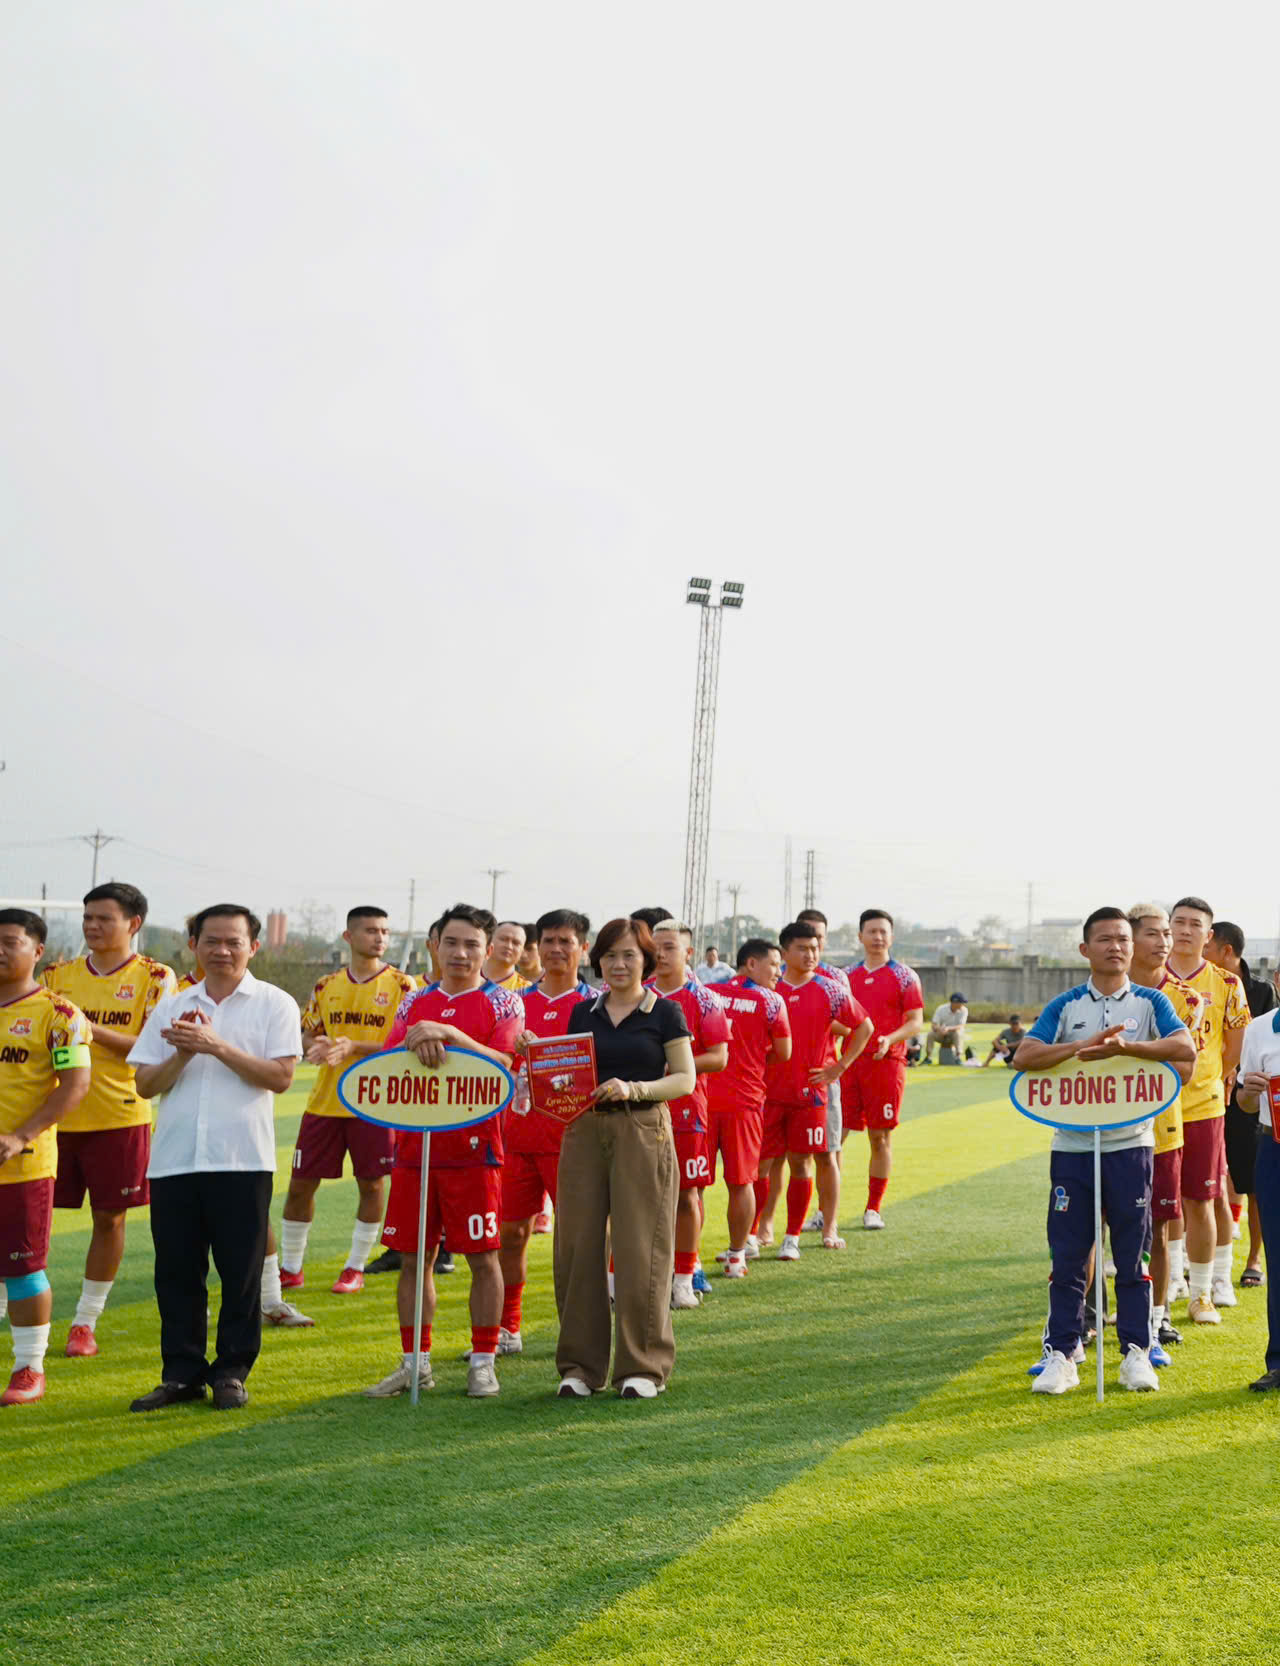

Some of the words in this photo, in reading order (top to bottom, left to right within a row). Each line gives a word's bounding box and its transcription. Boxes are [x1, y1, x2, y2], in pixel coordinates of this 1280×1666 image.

[102, 1011, 131, 1025] LAND
[364, 1012, 385, 1027] LAND
[0, 1045, 29, 1063] AND
[53, 1049, 69, 1065] C
[358, 1075, 381, 1104] FC
[387, 1069, 440, 1105] ĐÔNG
[446, 1076, 501, 1112] THỊNH
[1028, 1078, 1052, 1106] FC
[1059, 1071, 1116, 1105] ĐÔNG
[1123, 1068, 1163, 1103] TÂN
[883, 1103, 893, 1120] 6
[807, 1127, 824, 1145] 10
[686, 1155, 709, 1179] 02
[468, 1211, 498, 1240] 03
